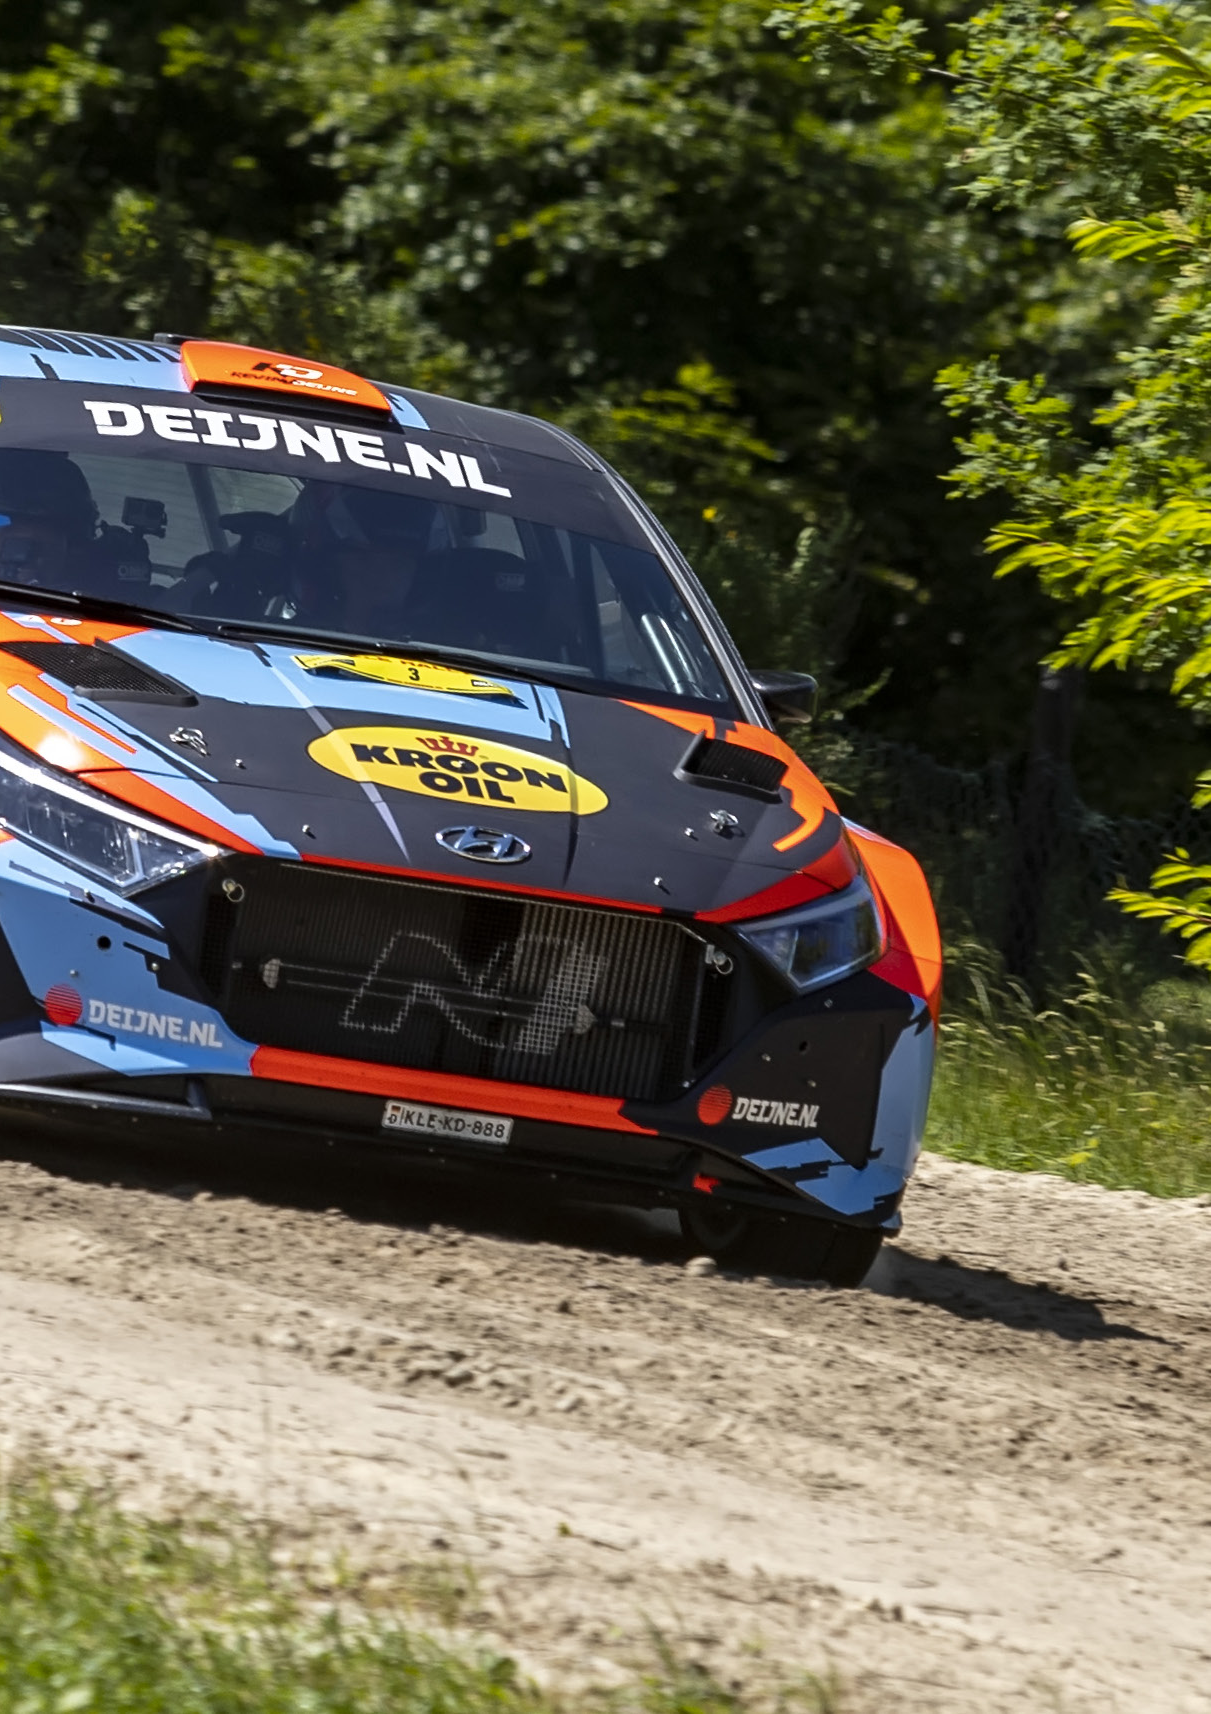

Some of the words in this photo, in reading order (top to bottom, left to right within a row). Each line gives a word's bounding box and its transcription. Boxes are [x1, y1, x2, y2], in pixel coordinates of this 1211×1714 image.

[83, 400, 512, 498] DEIJNE.NL
[408, 667, 420, 681] 3
[350, 743, 568, 793] KROON
[419, 771, 516, 804] OIL
[89, 1000, 223, 1048] DEIJNE.NL
[732, 1097, 819, 1128] DEIJNE.NL
